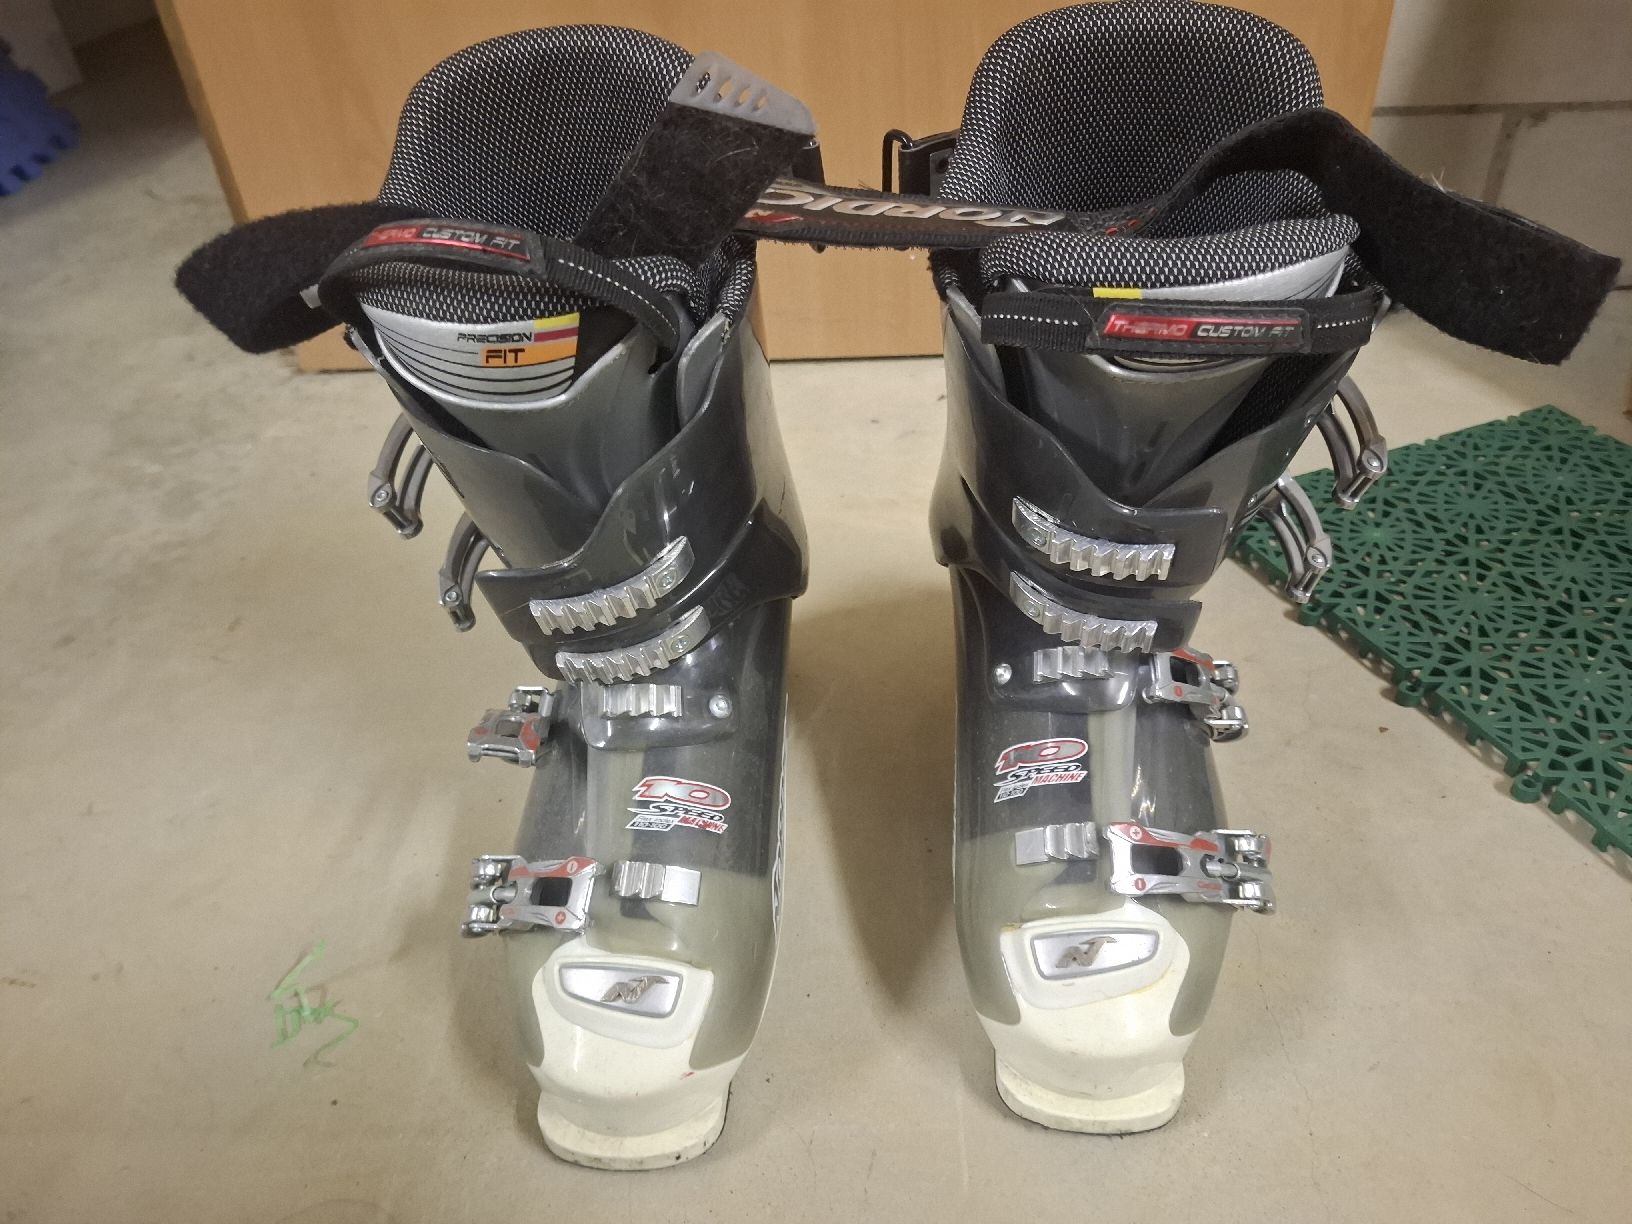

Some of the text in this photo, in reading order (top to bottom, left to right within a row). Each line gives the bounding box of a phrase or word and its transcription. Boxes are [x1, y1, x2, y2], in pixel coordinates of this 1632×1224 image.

[457, 332, 533, 343] PRECISION
[485, 347, 526, 365] FIT
[995, 738, 1088, 774] 10
[1004, 763, 1081, 782] SPEED
[1032, 772, 1084, 785] MACHINE
[642, 802, 724, 821] SPEED
